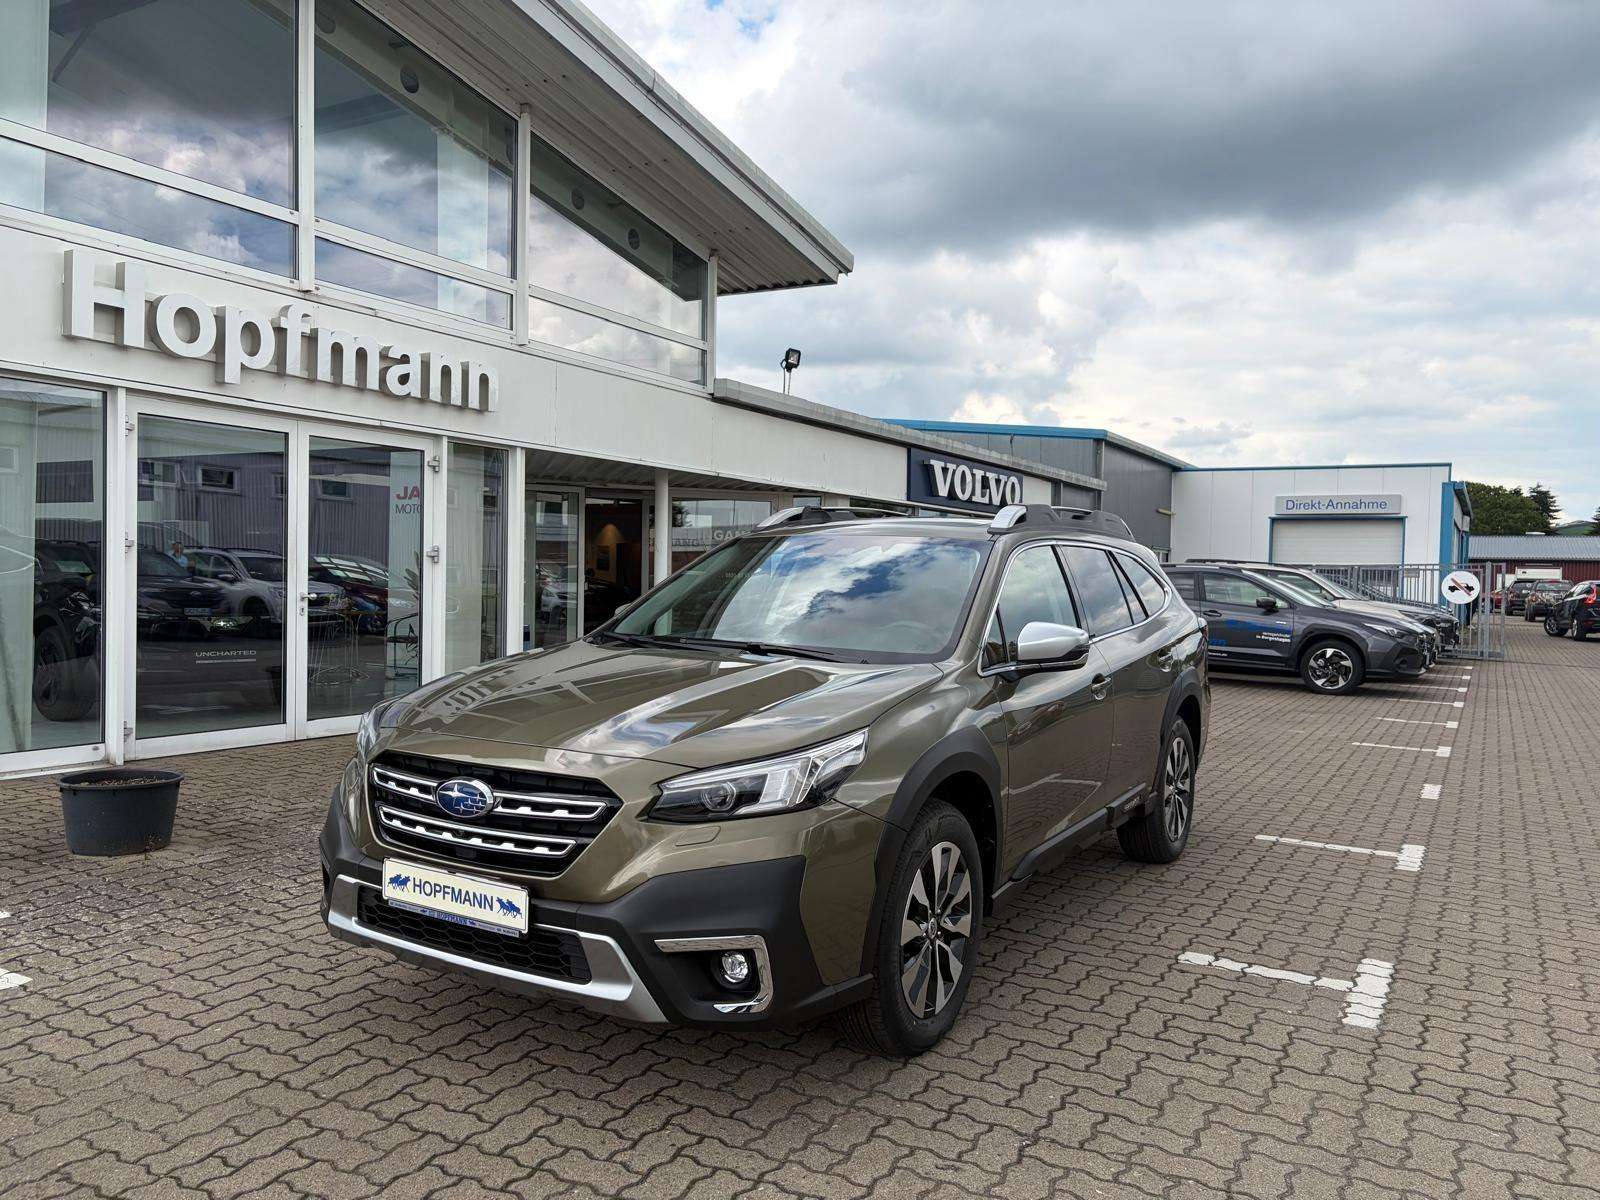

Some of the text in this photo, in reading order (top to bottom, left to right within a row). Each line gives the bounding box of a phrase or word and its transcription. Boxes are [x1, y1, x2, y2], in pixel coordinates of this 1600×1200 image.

[63, 249, 500, 412] Hopfmann
[929, 459, 1021, 506] VOLVO
[1285, 499, 1388, 511] Direkt-Annahme
[412, 876, 494, 911] HOPFMANN
